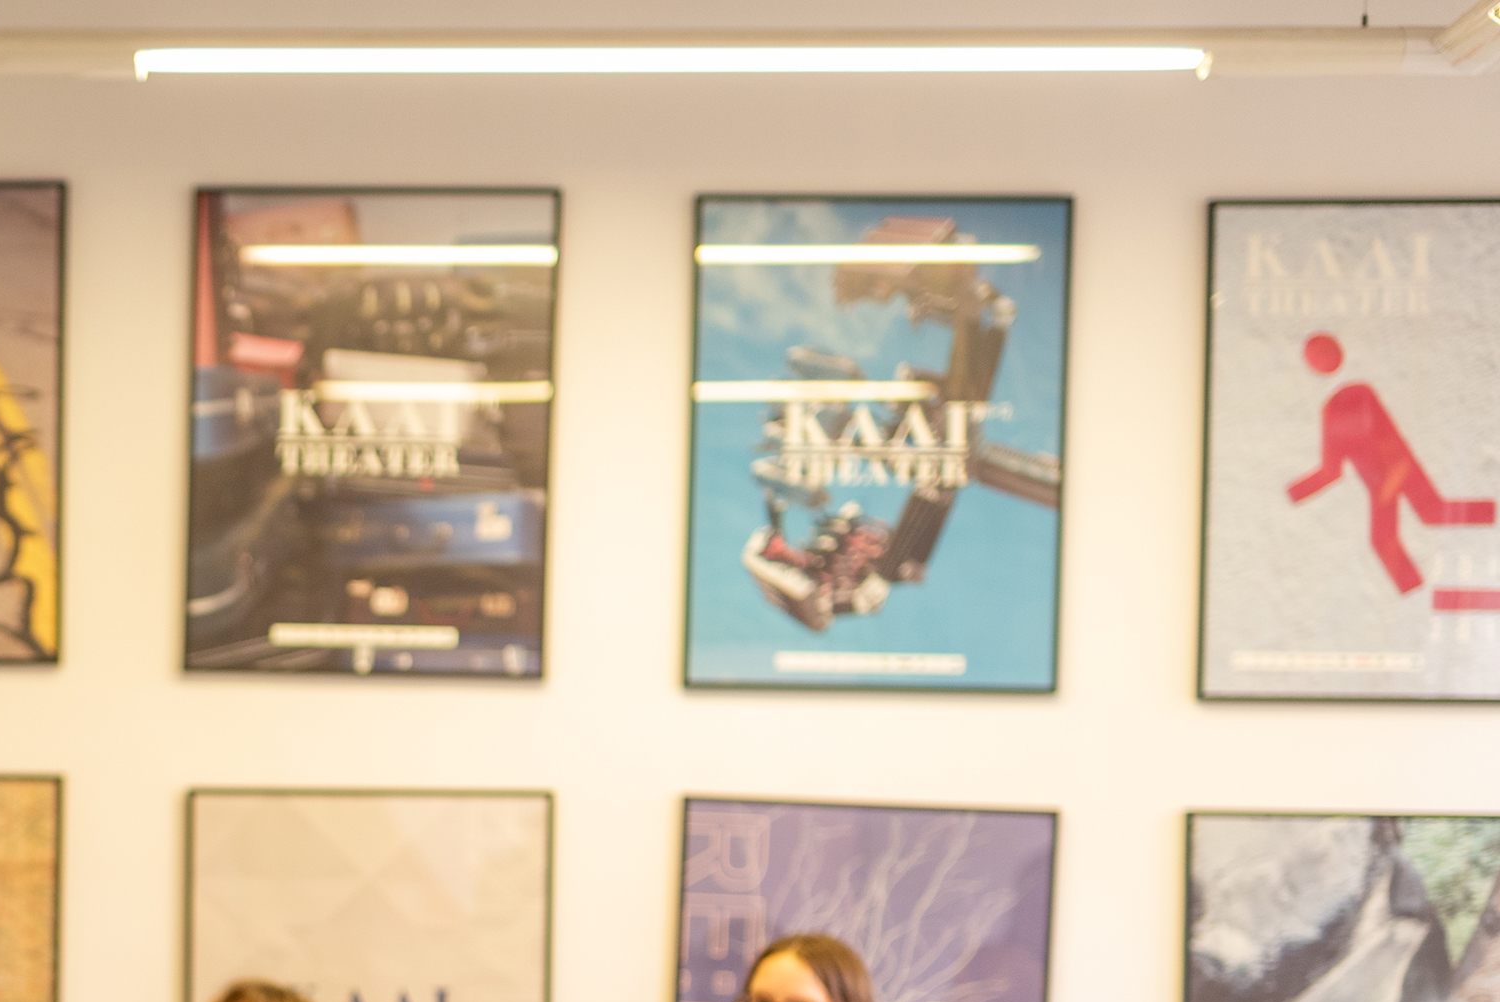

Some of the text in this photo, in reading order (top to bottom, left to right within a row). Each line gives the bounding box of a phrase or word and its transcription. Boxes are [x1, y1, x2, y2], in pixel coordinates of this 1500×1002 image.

[1243, 232, 1433, 278] KAAI
[278, 388, 461, 435] KAAI
[782, 400, 972, 448] KAAI
[275, 443, 460, 478] THEATER
[782, 456, 970, 488] THEATER
